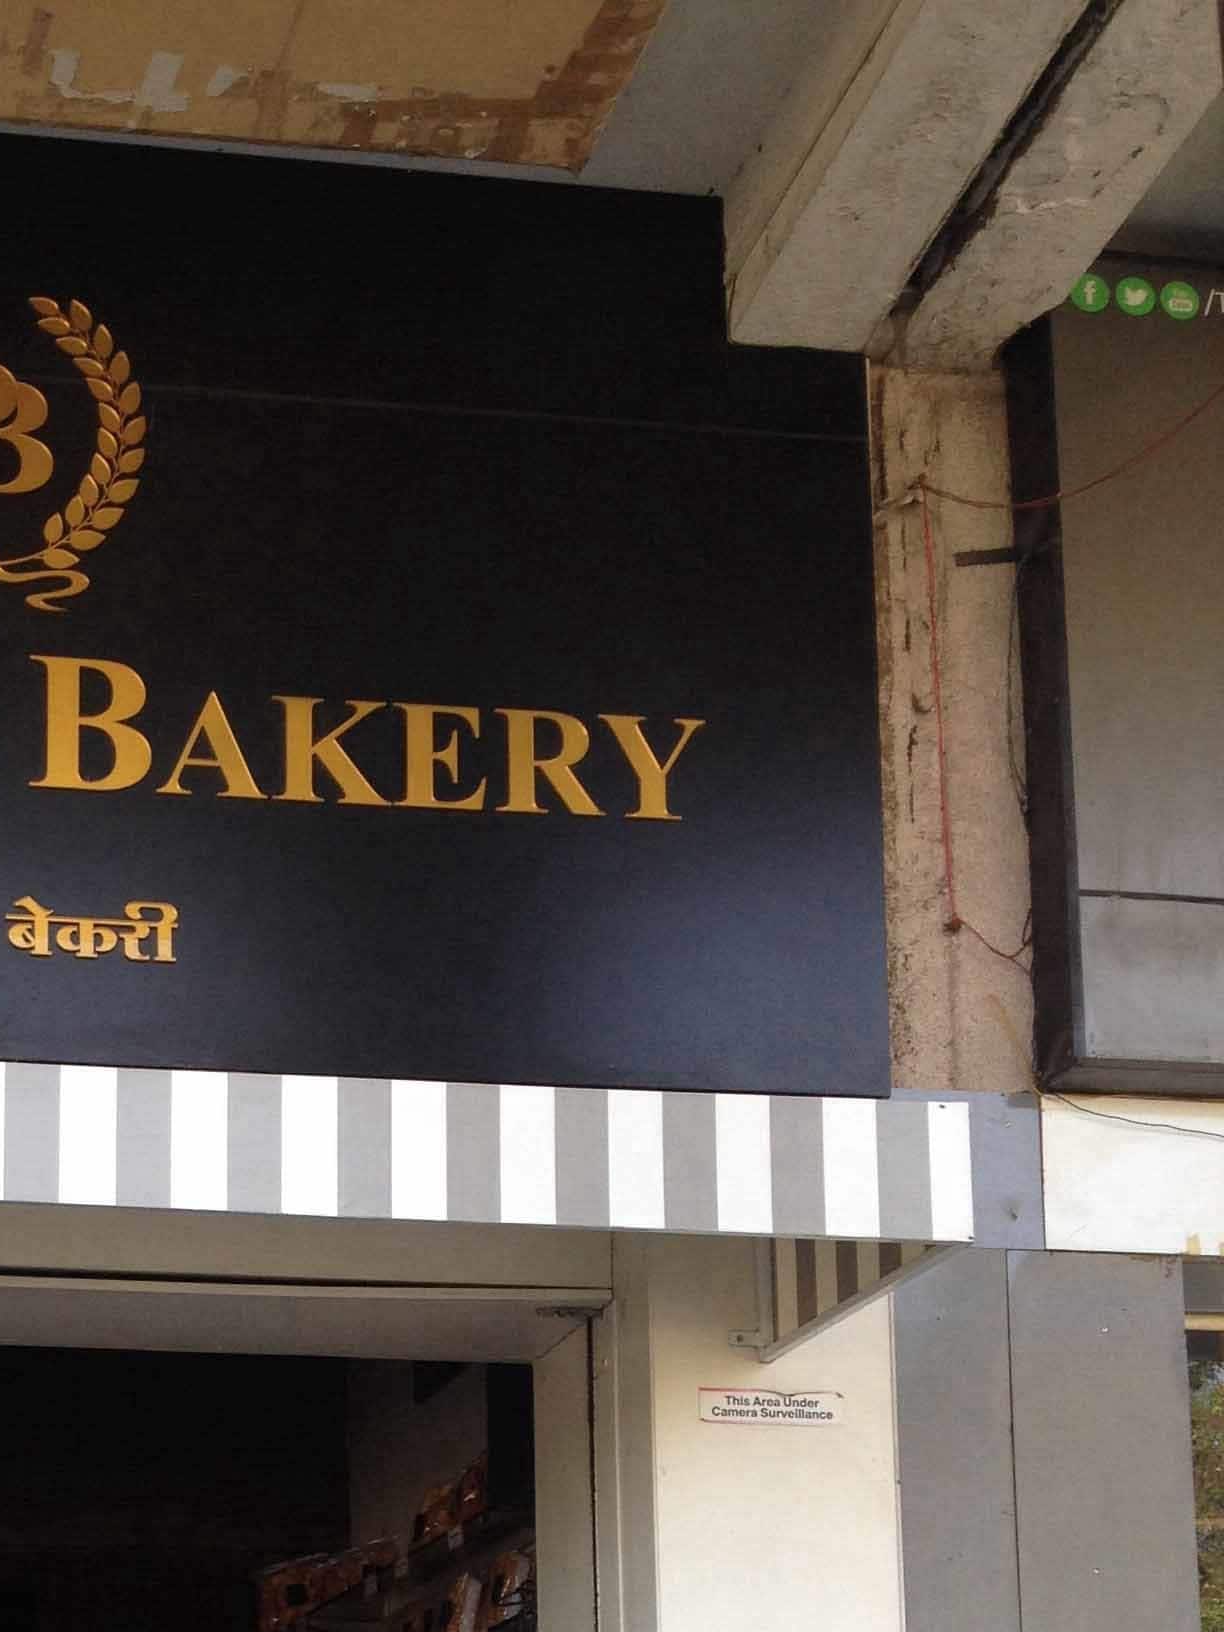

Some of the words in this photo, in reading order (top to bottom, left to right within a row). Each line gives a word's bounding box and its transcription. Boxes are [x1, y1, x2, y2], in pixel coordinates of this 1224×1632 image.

[27, 654, 707, 820] BAKERY
[5, 895, 179, 963] बेकरी
[711, 1406, 758, 1418] Camera
[760, 1408, 833, 1421] Surveillance
[725, 1395, 750, 1407] This
[753, 1396, 781, 1408] Area
[784, 1397, 820, 1409] Under
